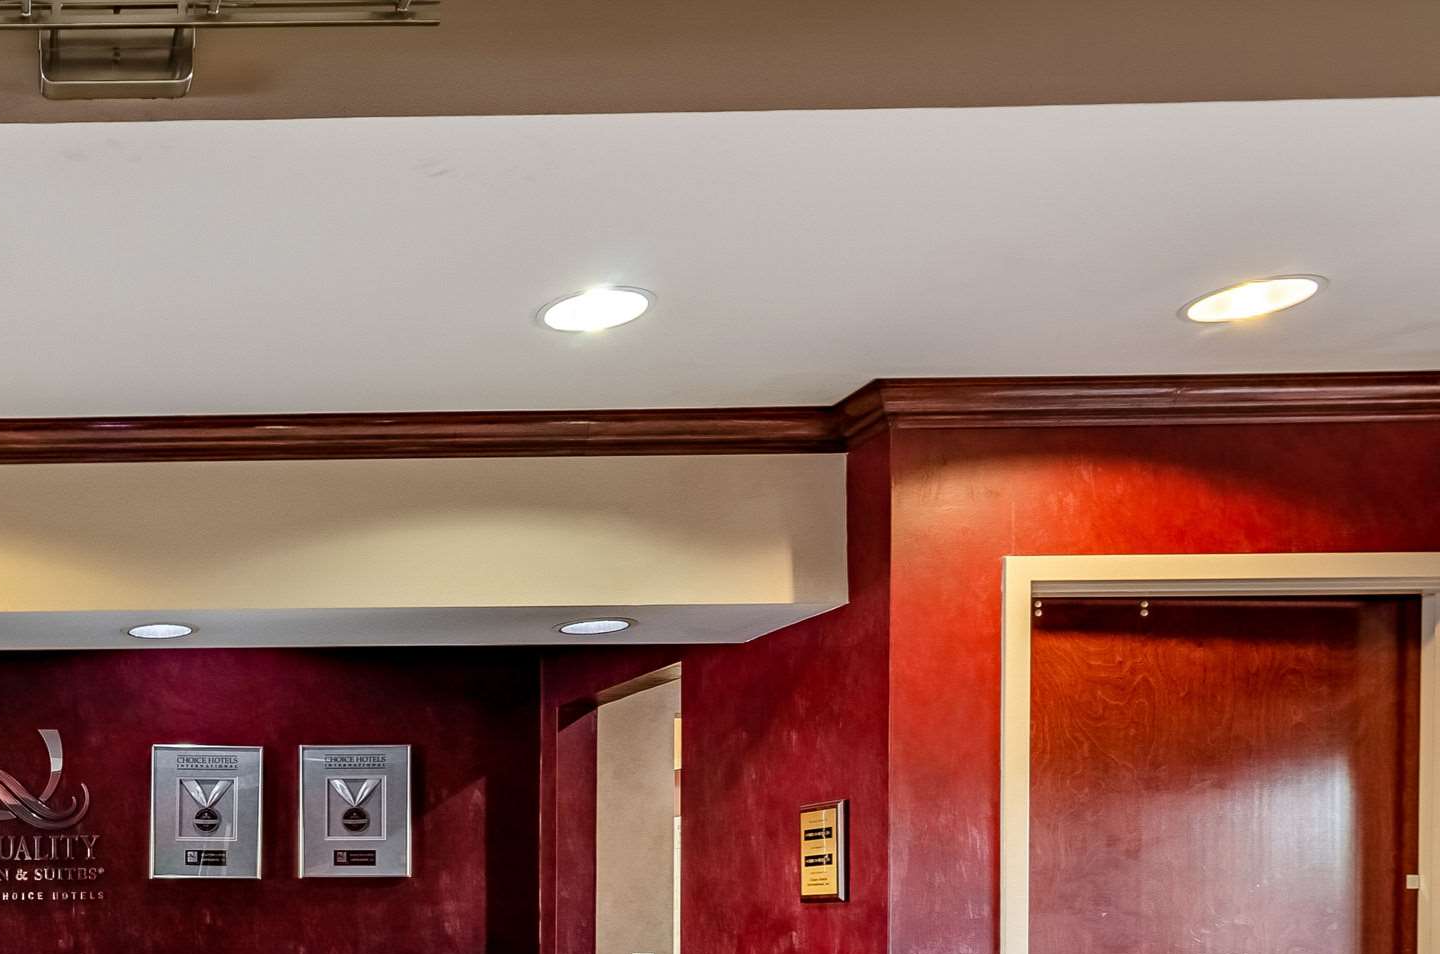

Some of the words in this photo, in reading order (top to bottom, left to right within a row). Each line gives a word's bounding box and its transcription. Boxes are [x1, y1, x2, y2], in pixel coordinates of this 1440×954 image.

[15, 868, 28, 881] &
[34, 868, 98, 881] SUITES
[52, 892, 104, 901] HOTELS
